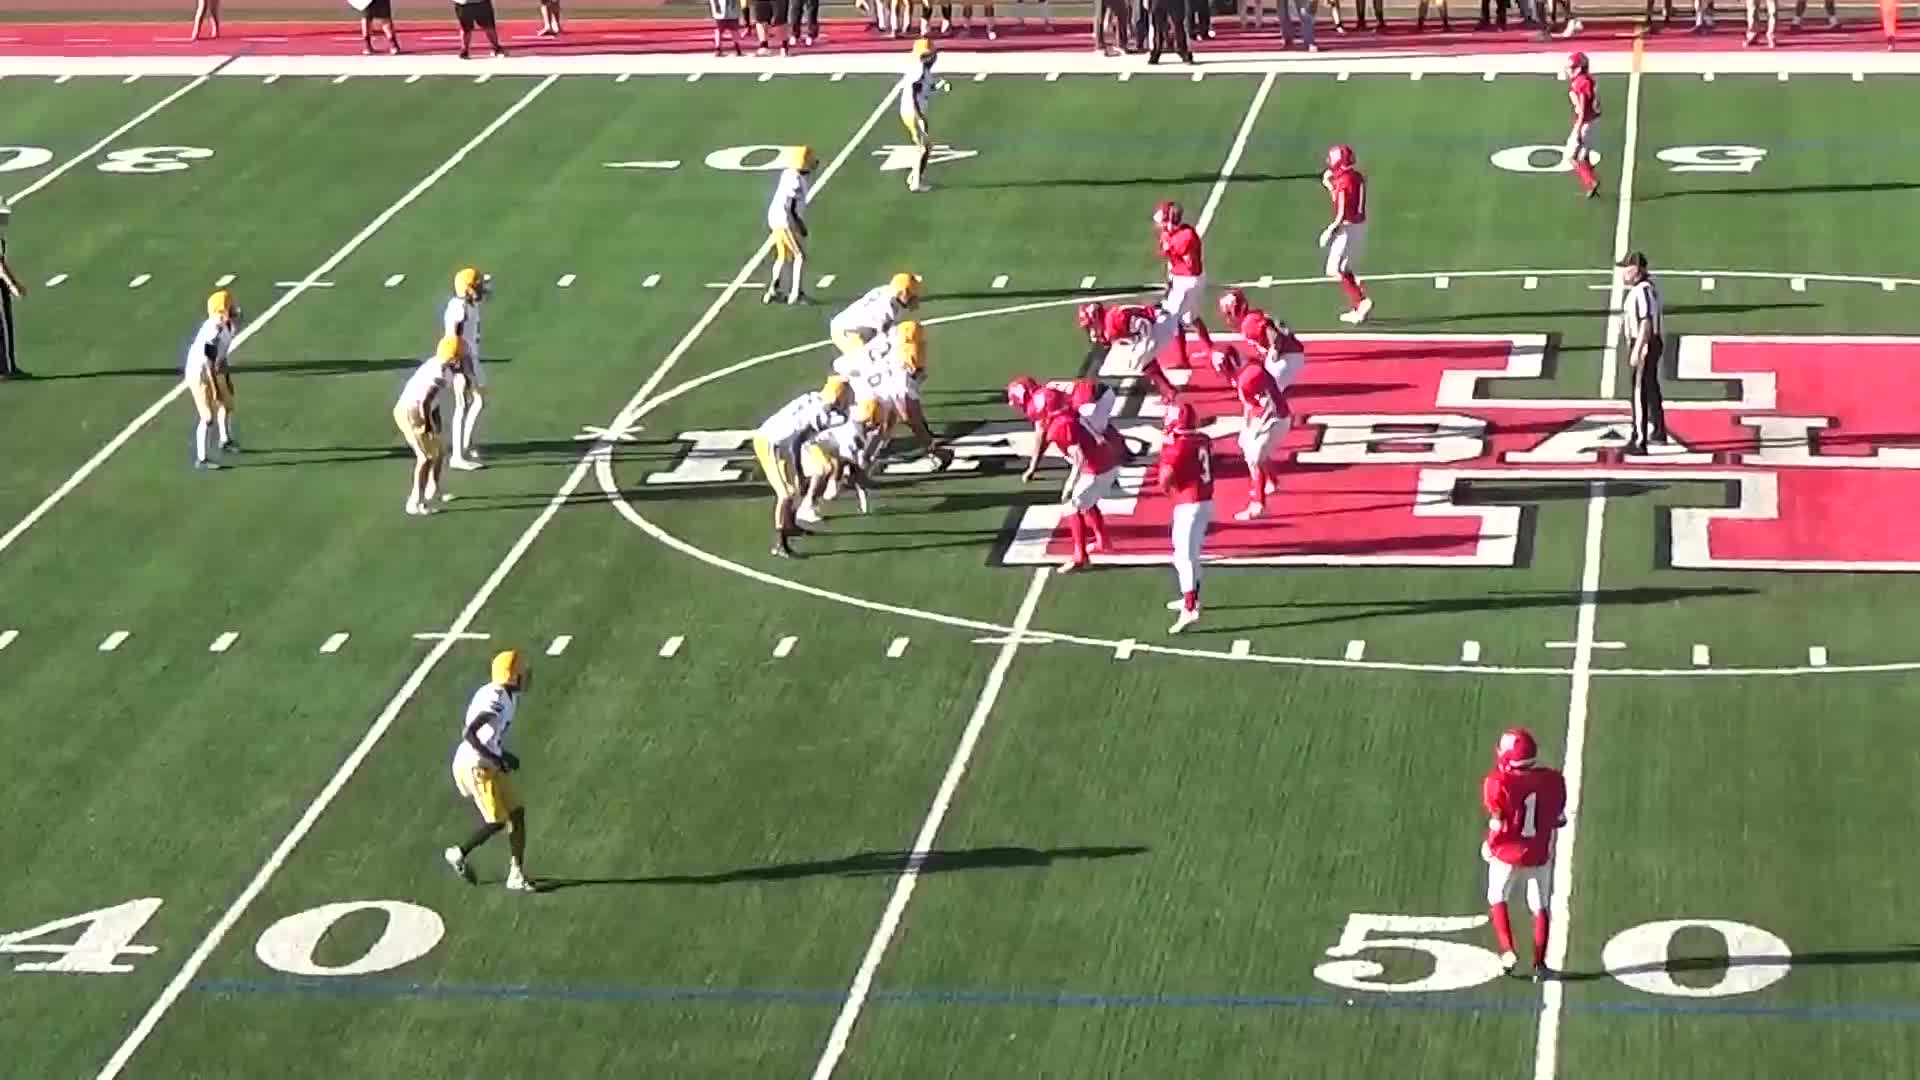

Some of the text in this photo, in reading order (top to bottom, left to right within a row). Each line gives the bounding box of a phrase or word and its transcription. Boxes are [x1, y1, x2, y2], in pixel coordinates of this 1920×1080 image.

[1490, 145, 1767, 172] 50
[1521, 792, 1537, 837] 1
[0, 897, 445, 975] 40
[1313, 912, 1792, 997] 50
